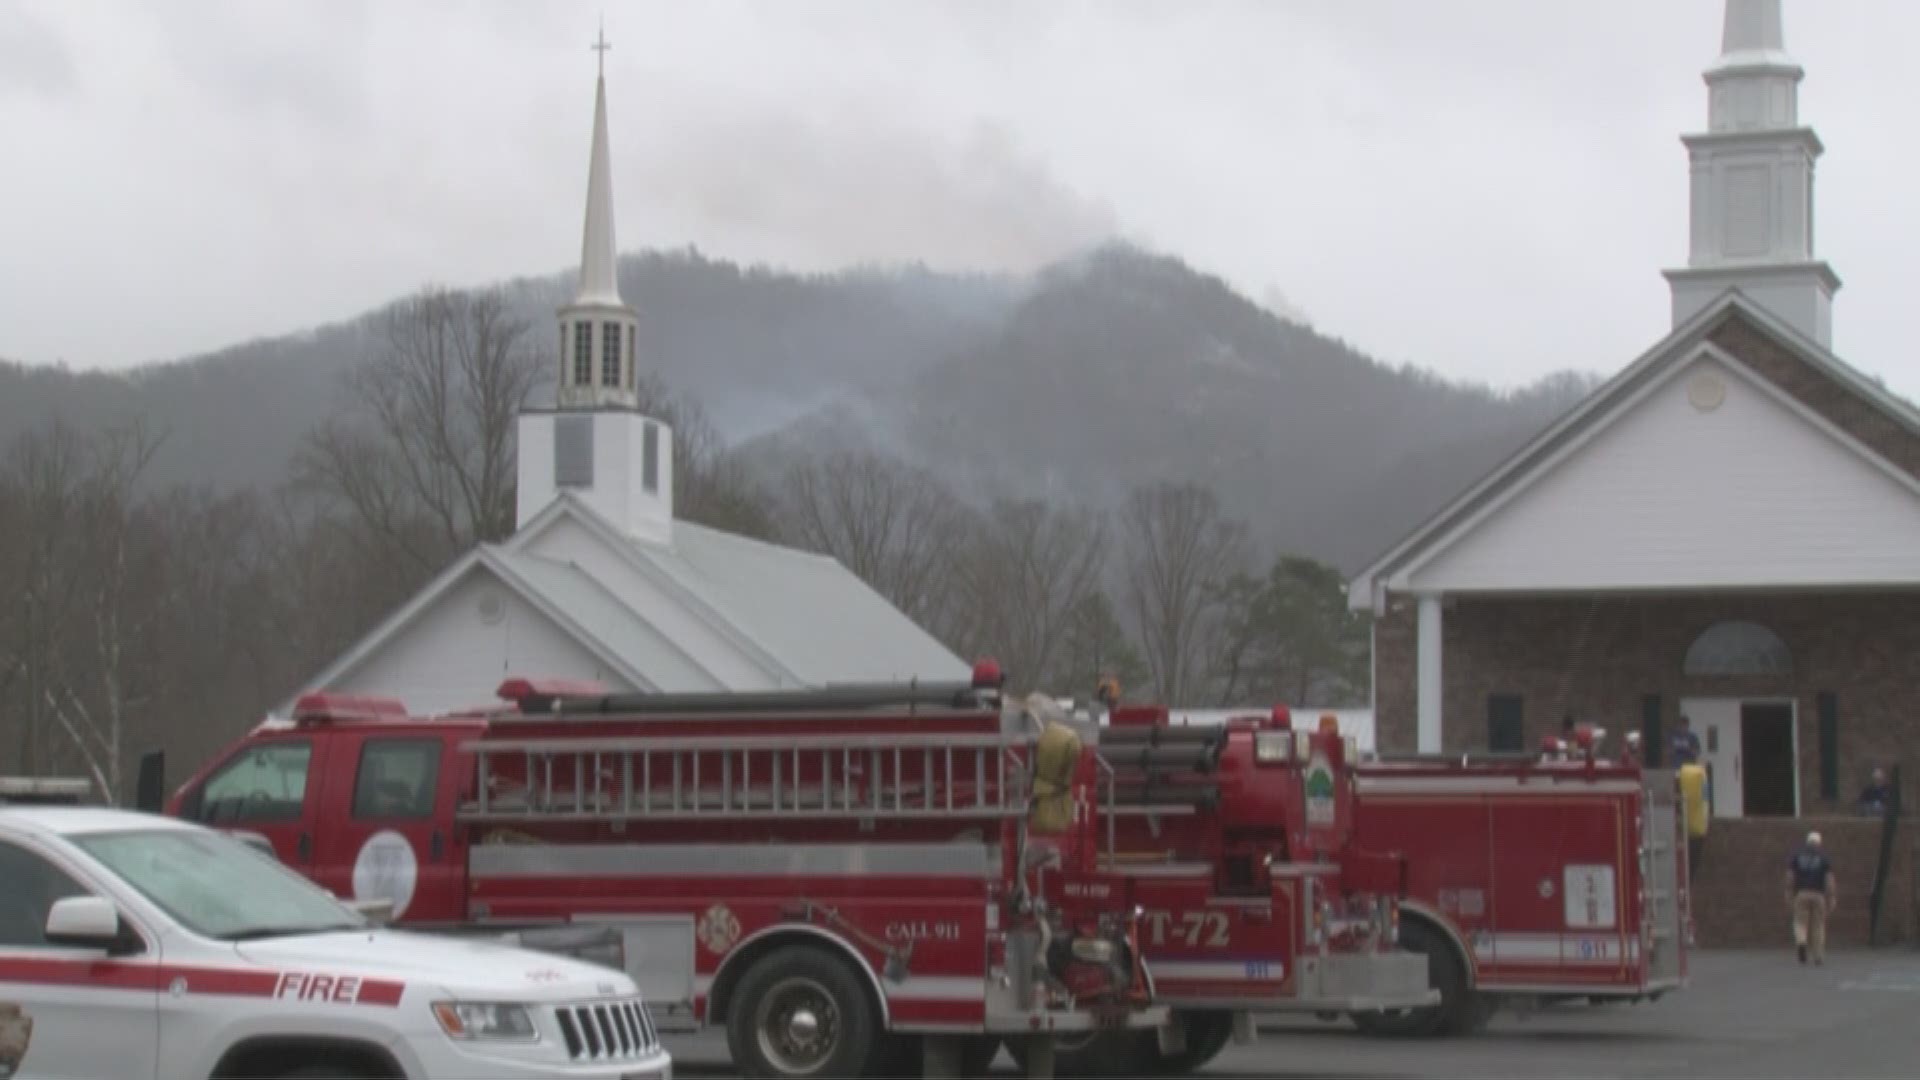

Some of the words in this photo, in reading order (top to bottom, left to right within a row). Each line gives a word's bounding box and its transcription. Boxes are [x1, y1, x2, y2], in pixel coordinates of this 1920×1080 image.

[885, 920, 931, 940] CALL
[934, 921, 960, 941] 911
[1144, 911, 1230, 946] T-72
[277, 972, 360, 1004] FIRE
